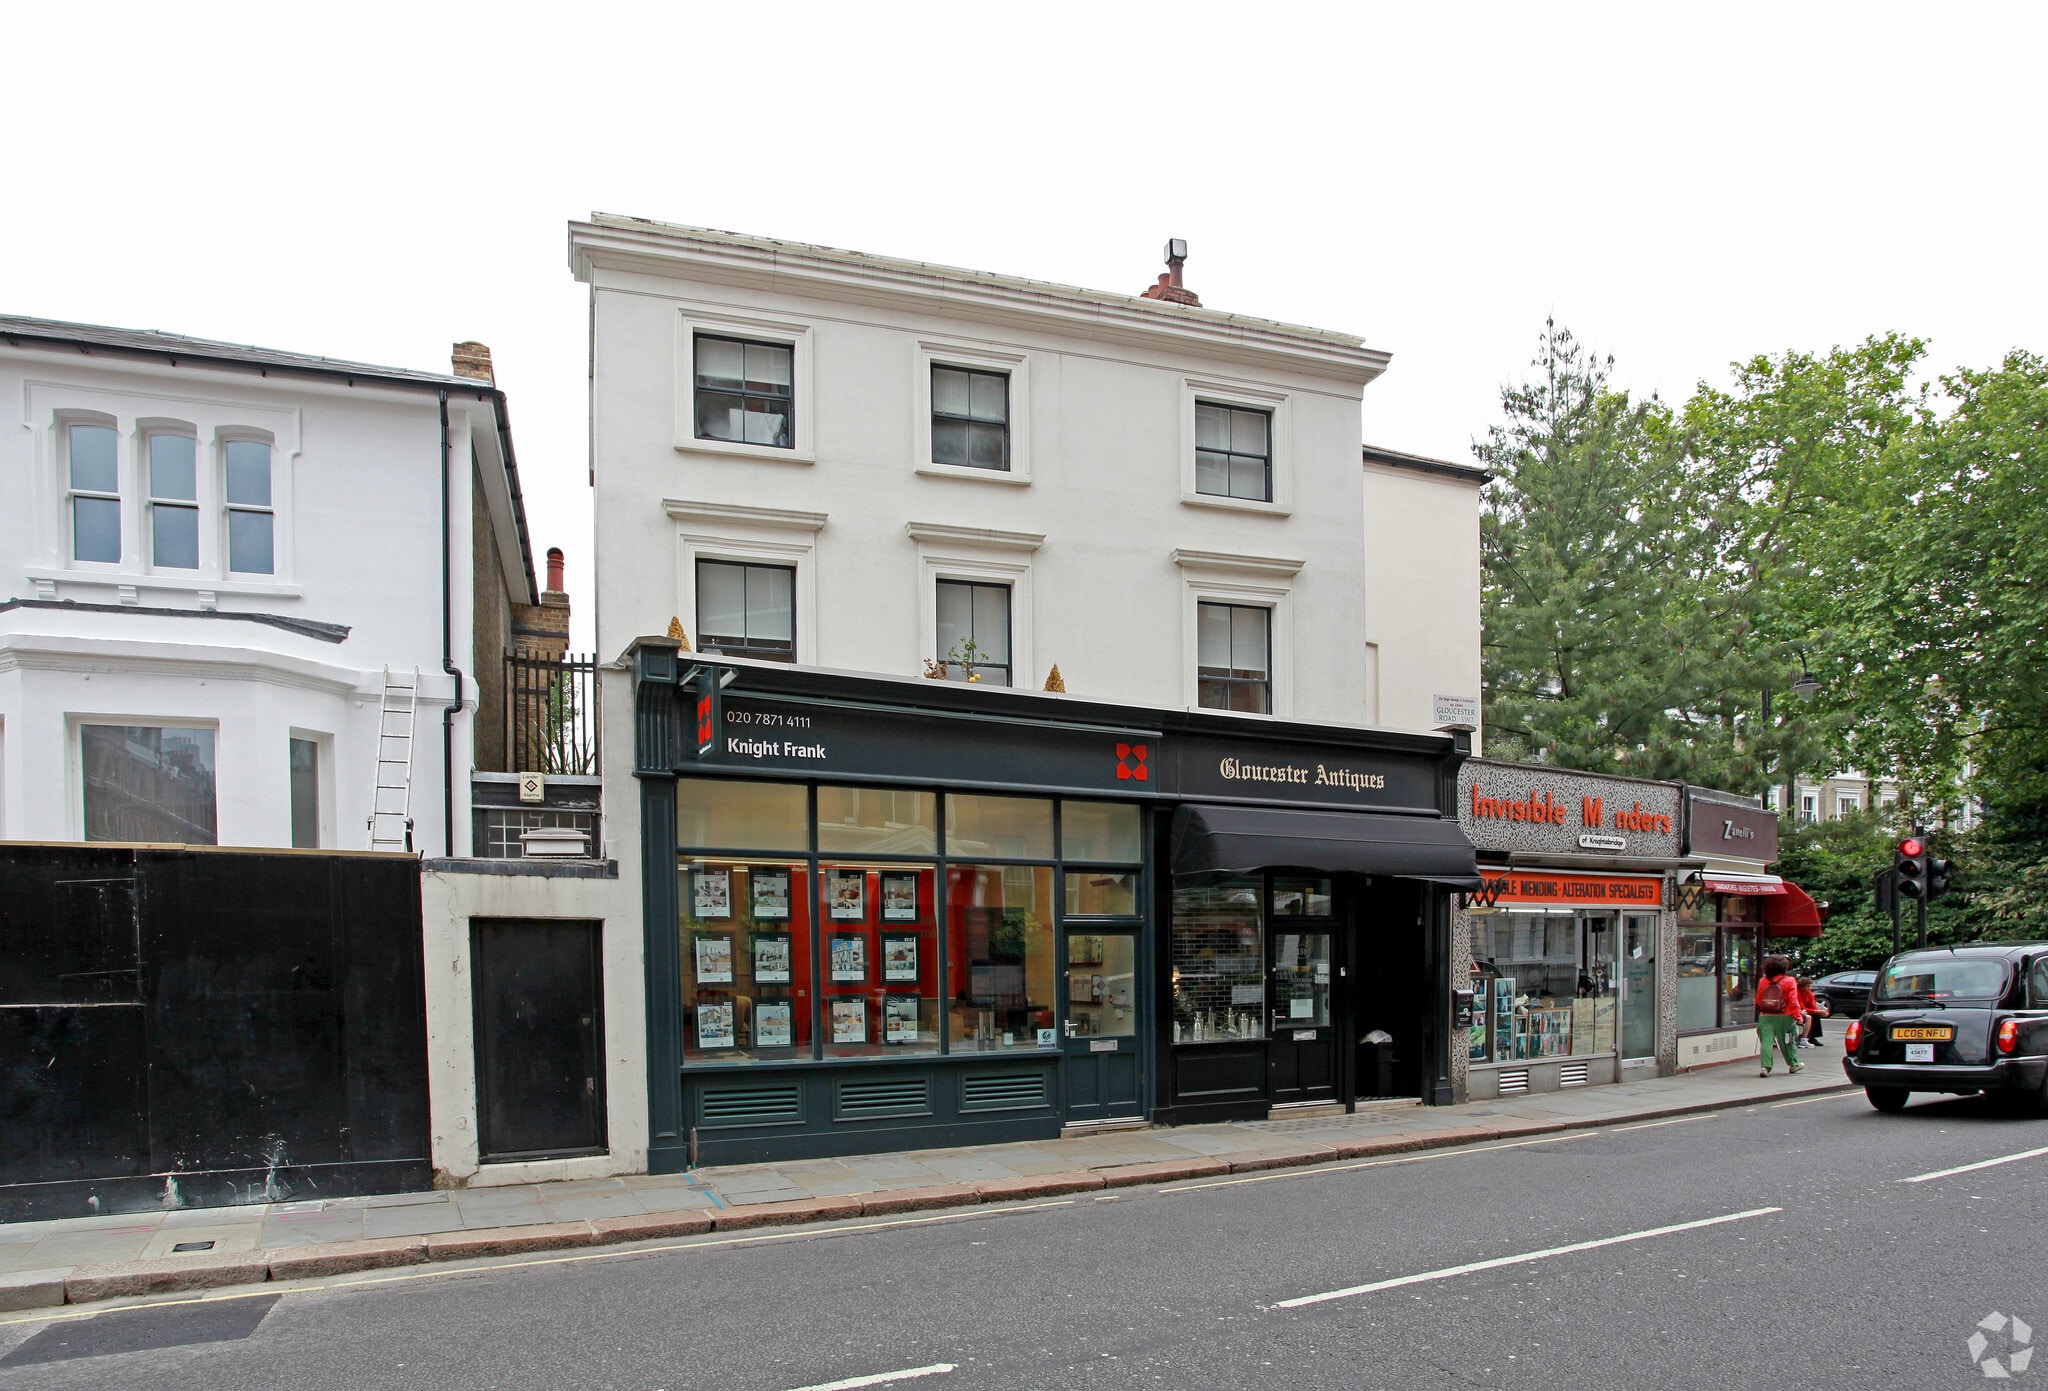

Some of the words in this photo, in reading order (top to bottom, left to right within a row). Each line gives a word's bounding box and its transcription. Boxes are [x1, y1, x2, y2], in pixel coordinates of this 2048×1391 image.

[727, 710, 751, 724] 020
[755, 713, 783, 726] 7871
[786, 716, 811, 728] 4111
[1436, 706, 1476, 717] GLOUCESTER
[727, 737, 780, 758] Knight
[784, 741, 827, 759] Frank
[1219, 757, 1309, 784] Gloucester
[1314, 764, 1385, 792] Antiques
[1472, 783, 1567, 825] Invisible
[1590, 836, 1624, 848] Knightsbridge
[1521, 880, 1558, 897] MENDING
[1562, 882, 1606, 899] ALTERATION
[1609, 884, 1654, 900] SPECIALISTS
[1897, 1029, 1923, 1038] LC06
[1926, 1029, 1947, 1038] NFU
